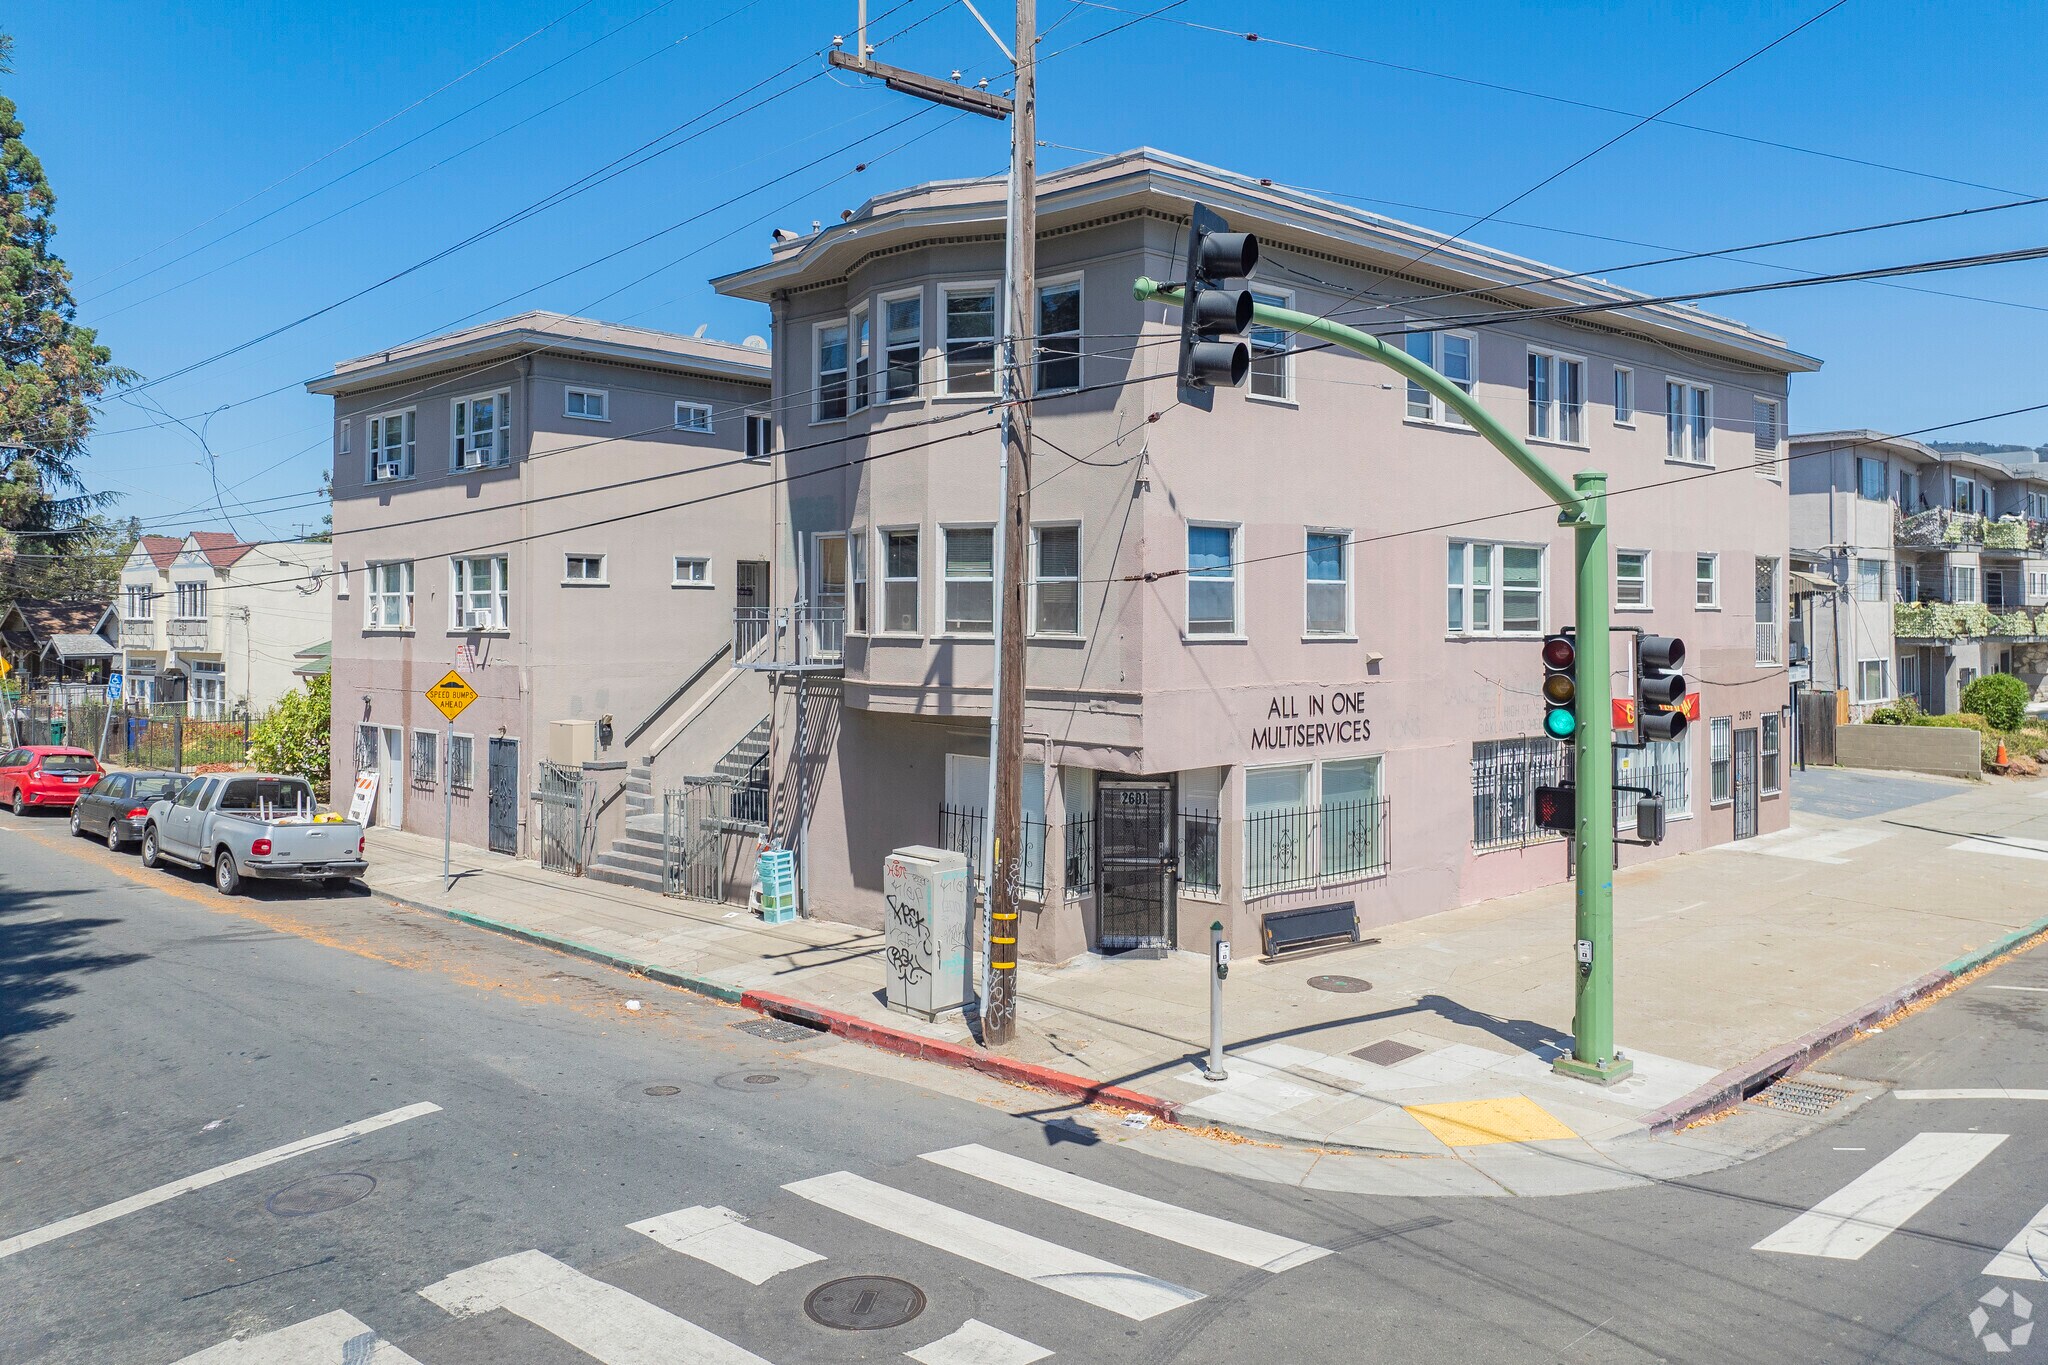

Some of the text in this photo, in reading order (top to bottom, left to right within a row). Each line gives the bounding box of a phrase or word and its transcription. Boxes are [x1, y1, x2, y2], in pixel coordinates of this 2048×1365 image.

[1268, 692, 1364, 719] ALL IN ONE
[1251, 719, 1371, 750] MULTISERVICES
[1122, 792, 1147, 804] 2601
